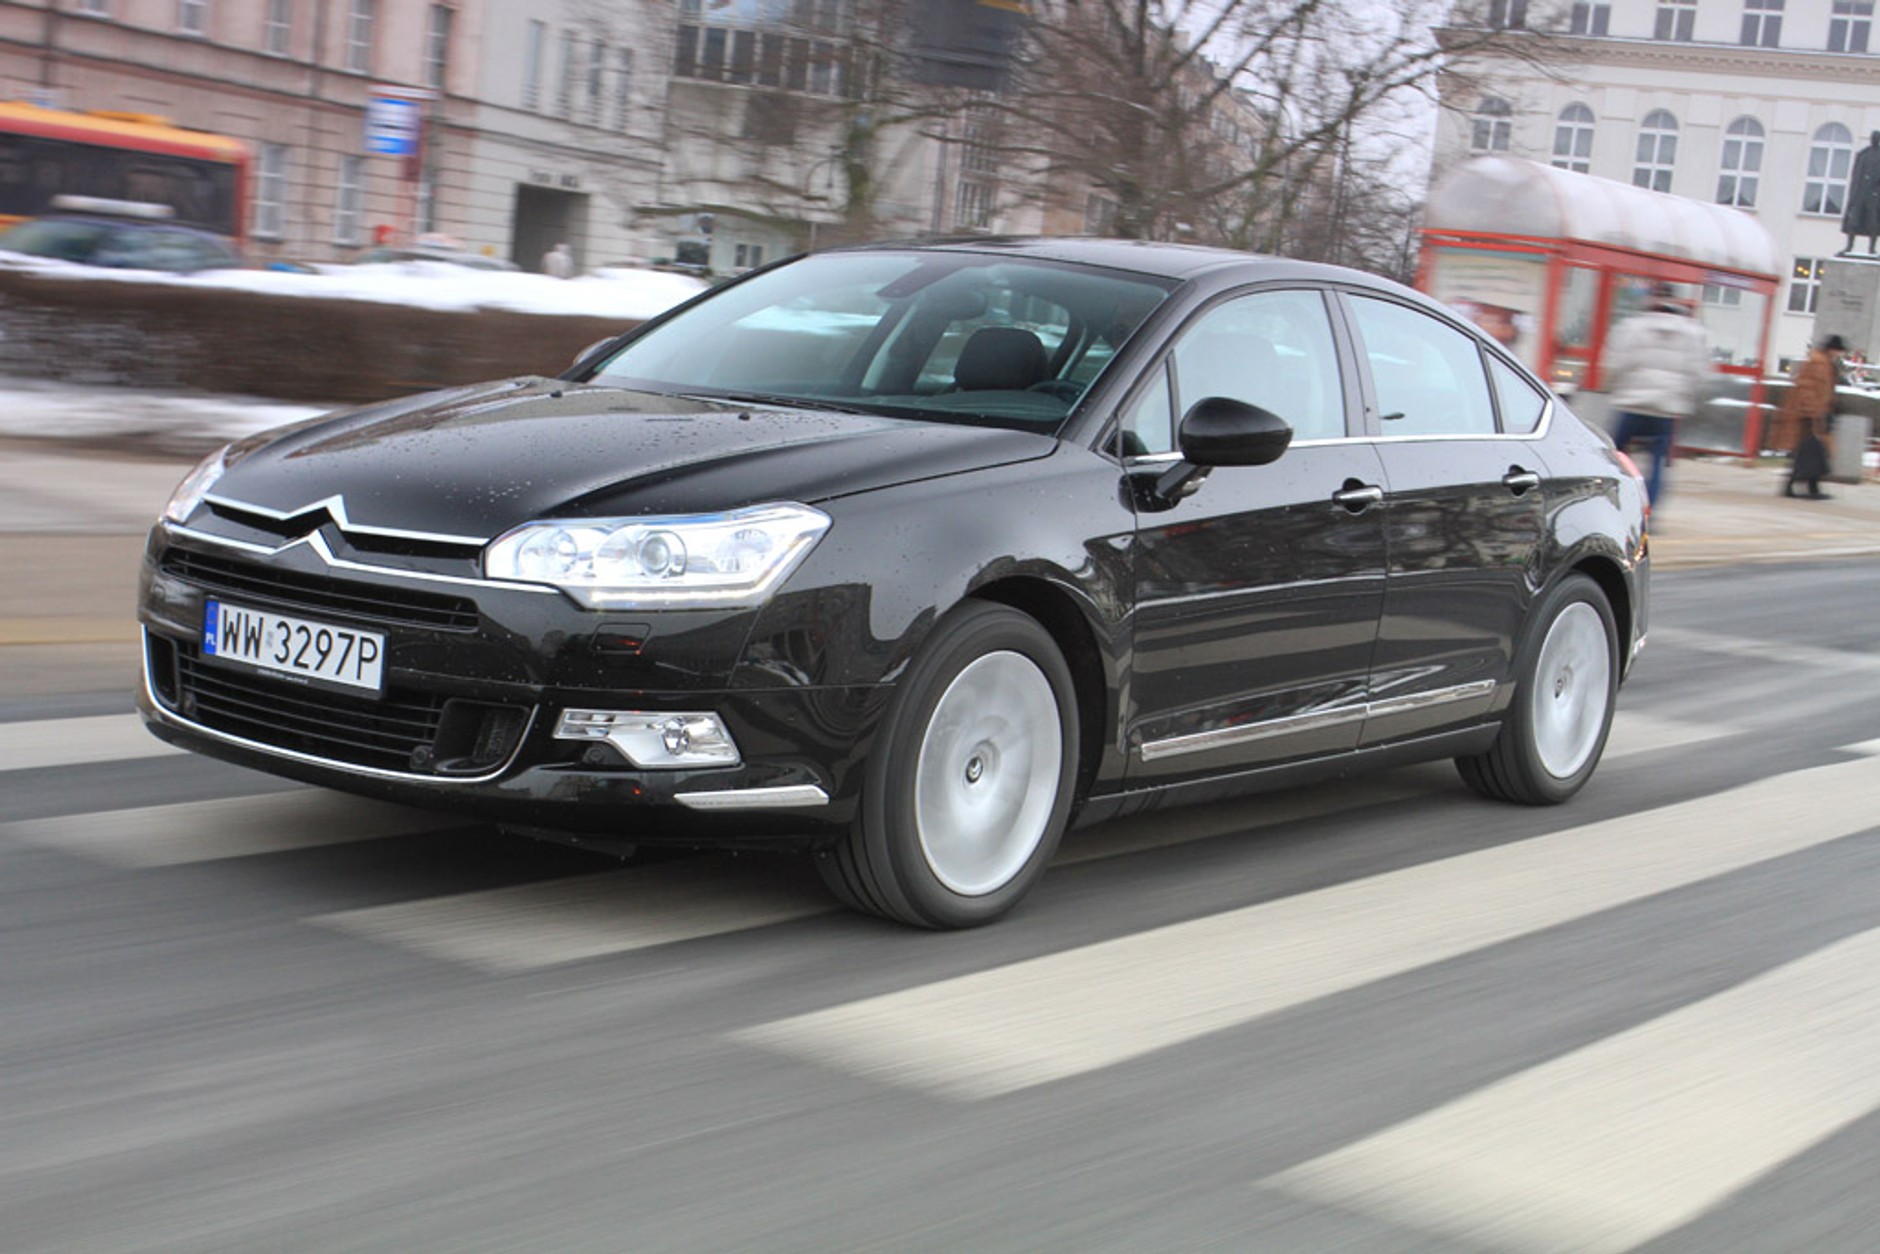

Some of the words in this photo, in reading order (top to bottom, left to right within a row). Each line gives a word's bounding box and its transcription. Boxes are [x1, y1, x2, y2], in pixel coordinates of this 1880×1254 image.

[205, 632, 216, 645] PL
[223, 609, 264, 658] WW
[274, 621, 378, 680] 3297P
